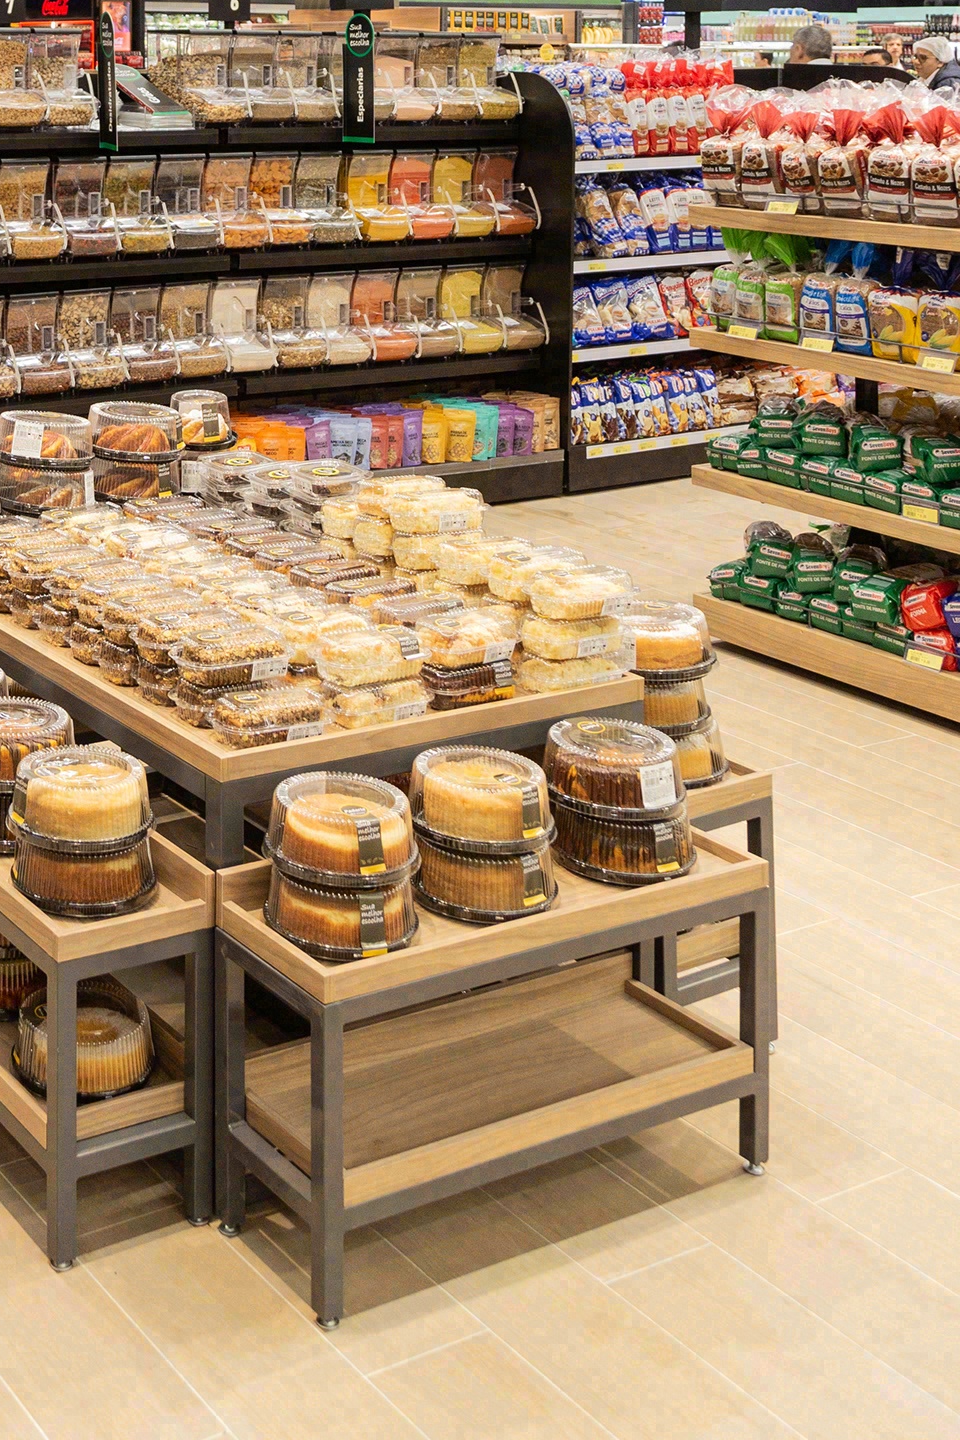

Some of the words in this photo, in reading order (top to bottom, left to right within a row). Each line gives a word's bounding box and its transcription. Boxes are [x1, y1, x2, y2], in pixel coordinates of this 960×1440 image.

[349, 23, 363, 31] Sua
[349, 31, 370, 39] melhor
[349, 39, 370, 47] escolha
[106, 61, 114, 133] Desidratados
[356, 66, 366, 123] Especiarias
[812, 426, 838, 435] SevenBoys
[869, 441, 896, 450] SevenBoys
[840, 471, 861, 481] SevenBoys
[872, 480, 894, 492] SevenBoys
[907, 486, 931, 496] SevenBoys
[767, 548, 792, 559] SevenBoys
[860, 591, 882, 600] SevenBoys
[358, 826, 380, 834] melhor
[358, 832, 381, 842] escolha
[361, 903, 376, 911] Sua
[361, 910, 383, 918] melhor
[361, 916, 384, 925] escolha
